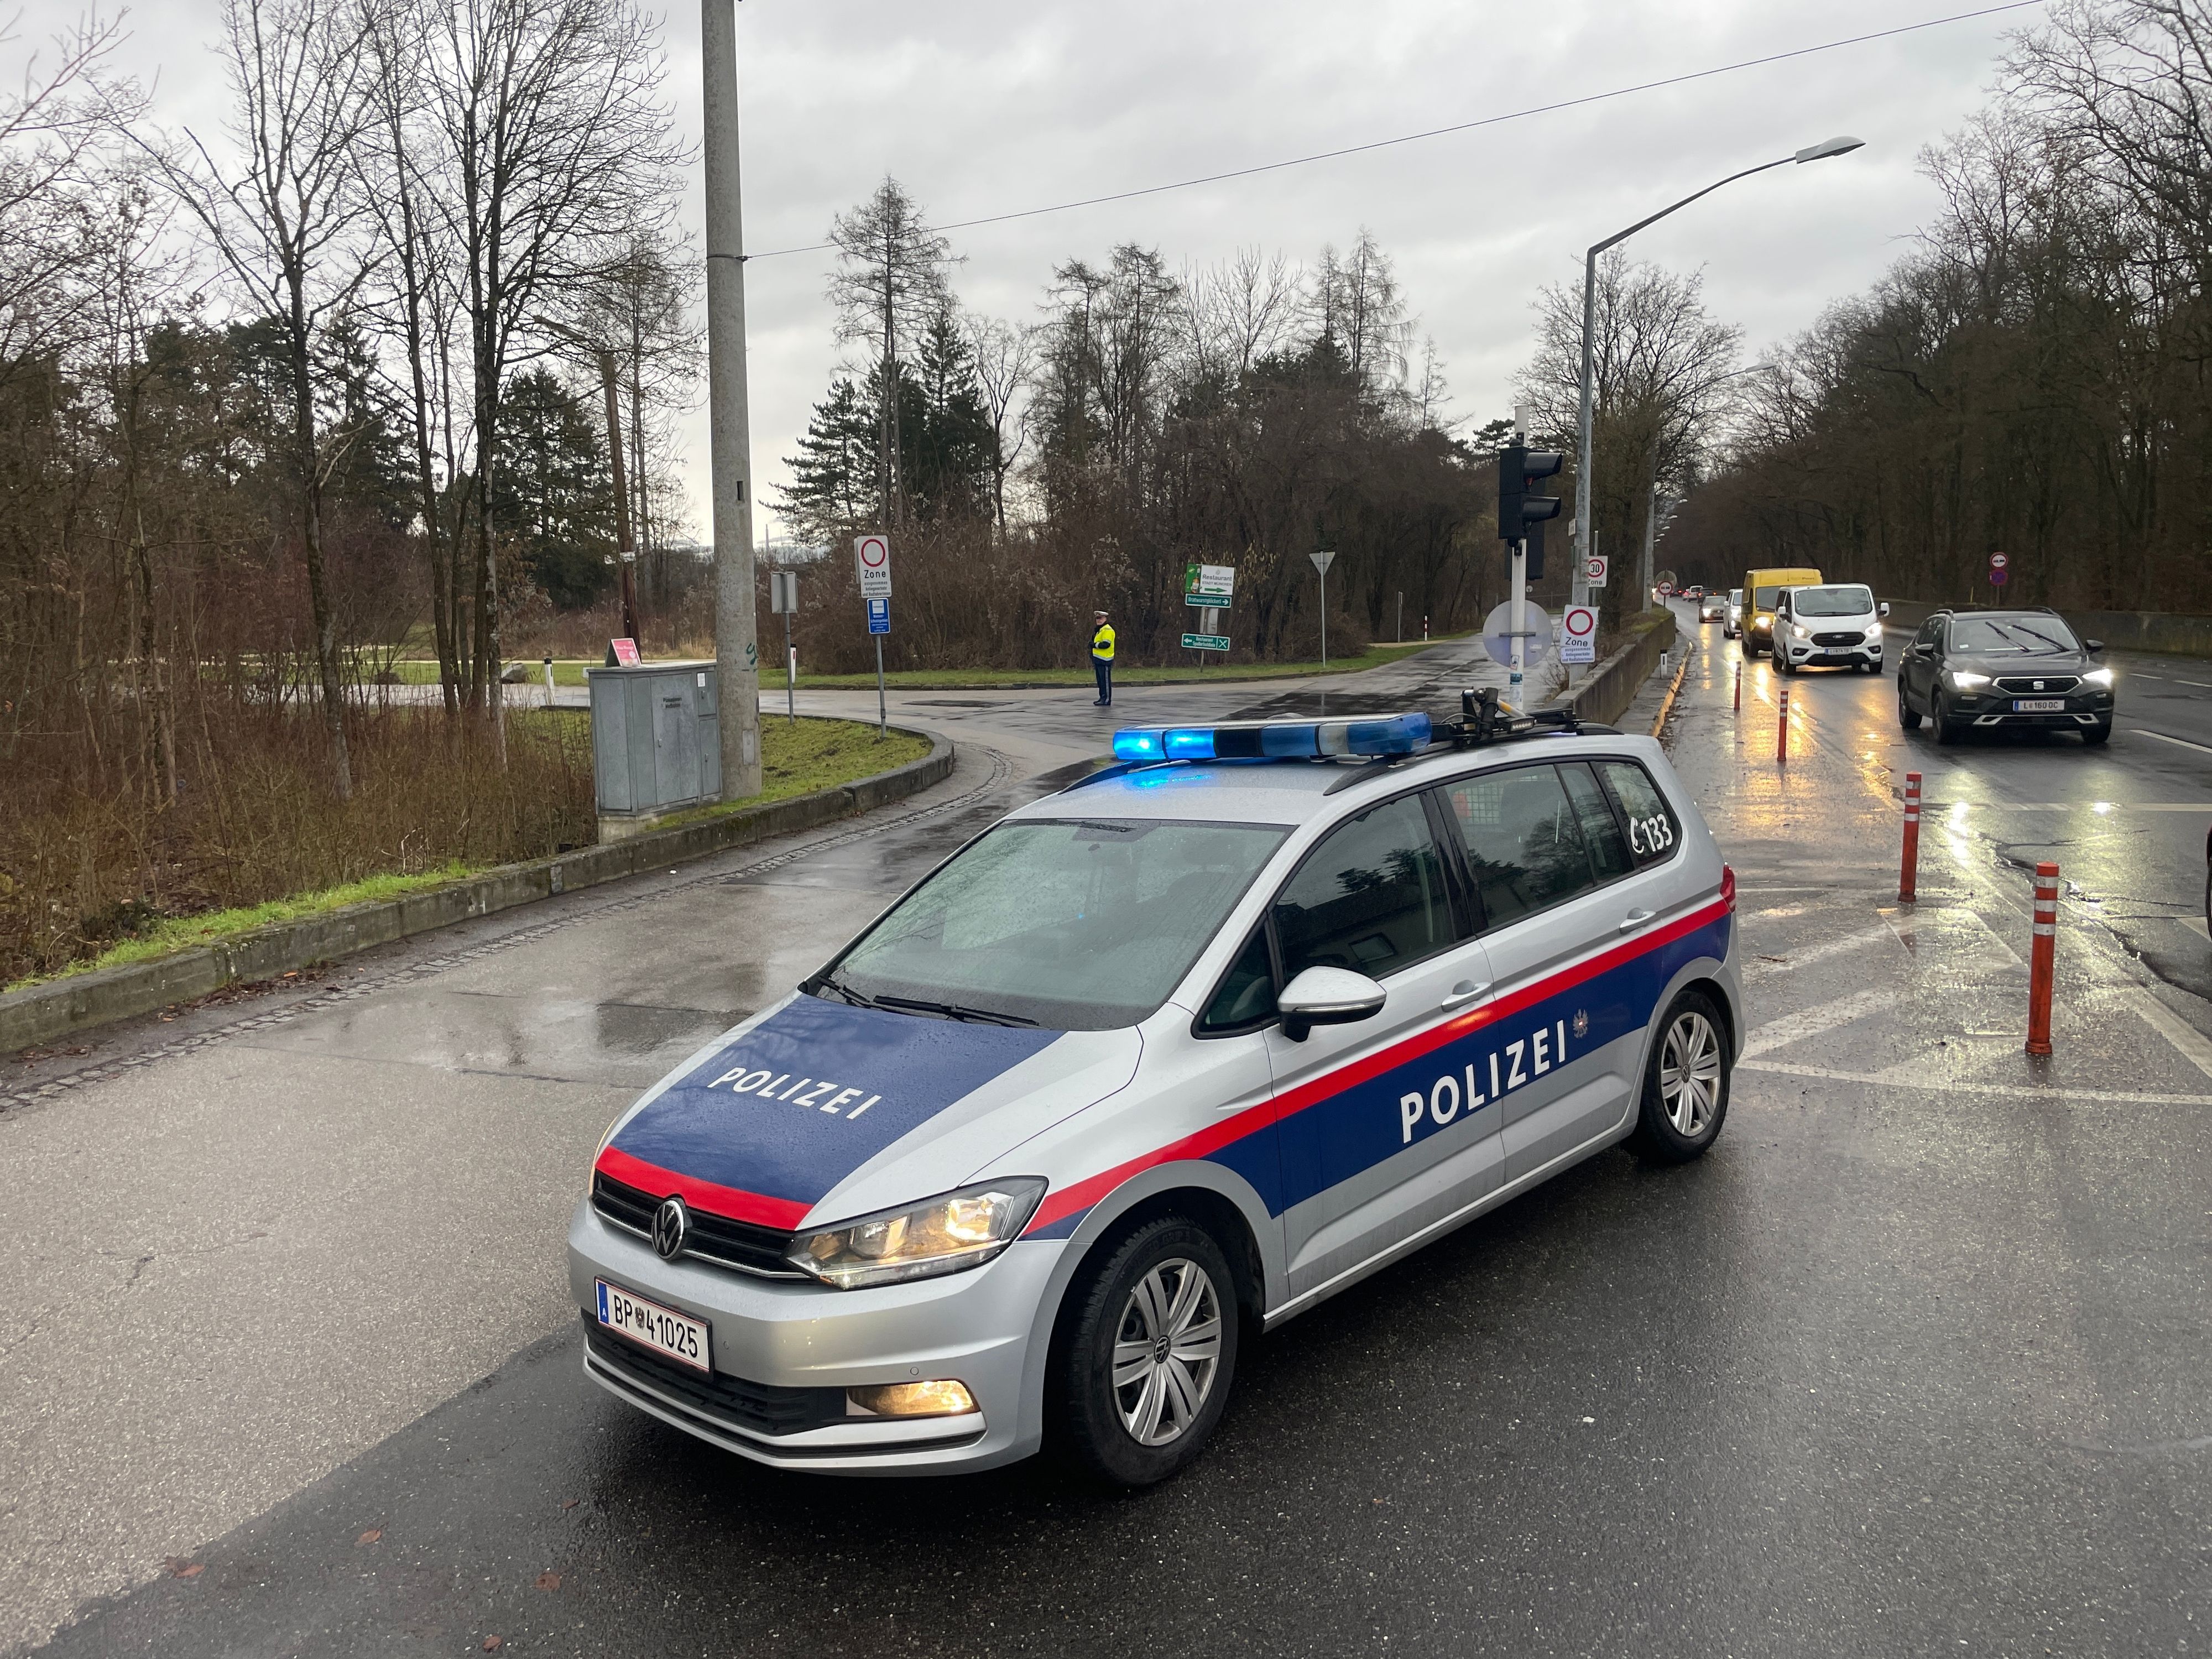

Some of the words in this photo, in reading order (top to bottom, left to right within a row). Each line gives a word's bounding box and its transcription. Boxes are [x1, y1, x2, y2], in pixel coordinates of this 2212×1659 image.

[864, 570, 886, 578] Zone
[1590, 564, 1600, 573] 30
[1565, 637, 1588, 646] Zone
[1641, 813, 1672, 852] 133
[707, 1067, 882, 1119] POLIZEI
[1400, 1020, 1566, 1144] POLIZEI
[614, 1295, 632, 1328] BP
[646, 1309, 698, 1358] 41025
